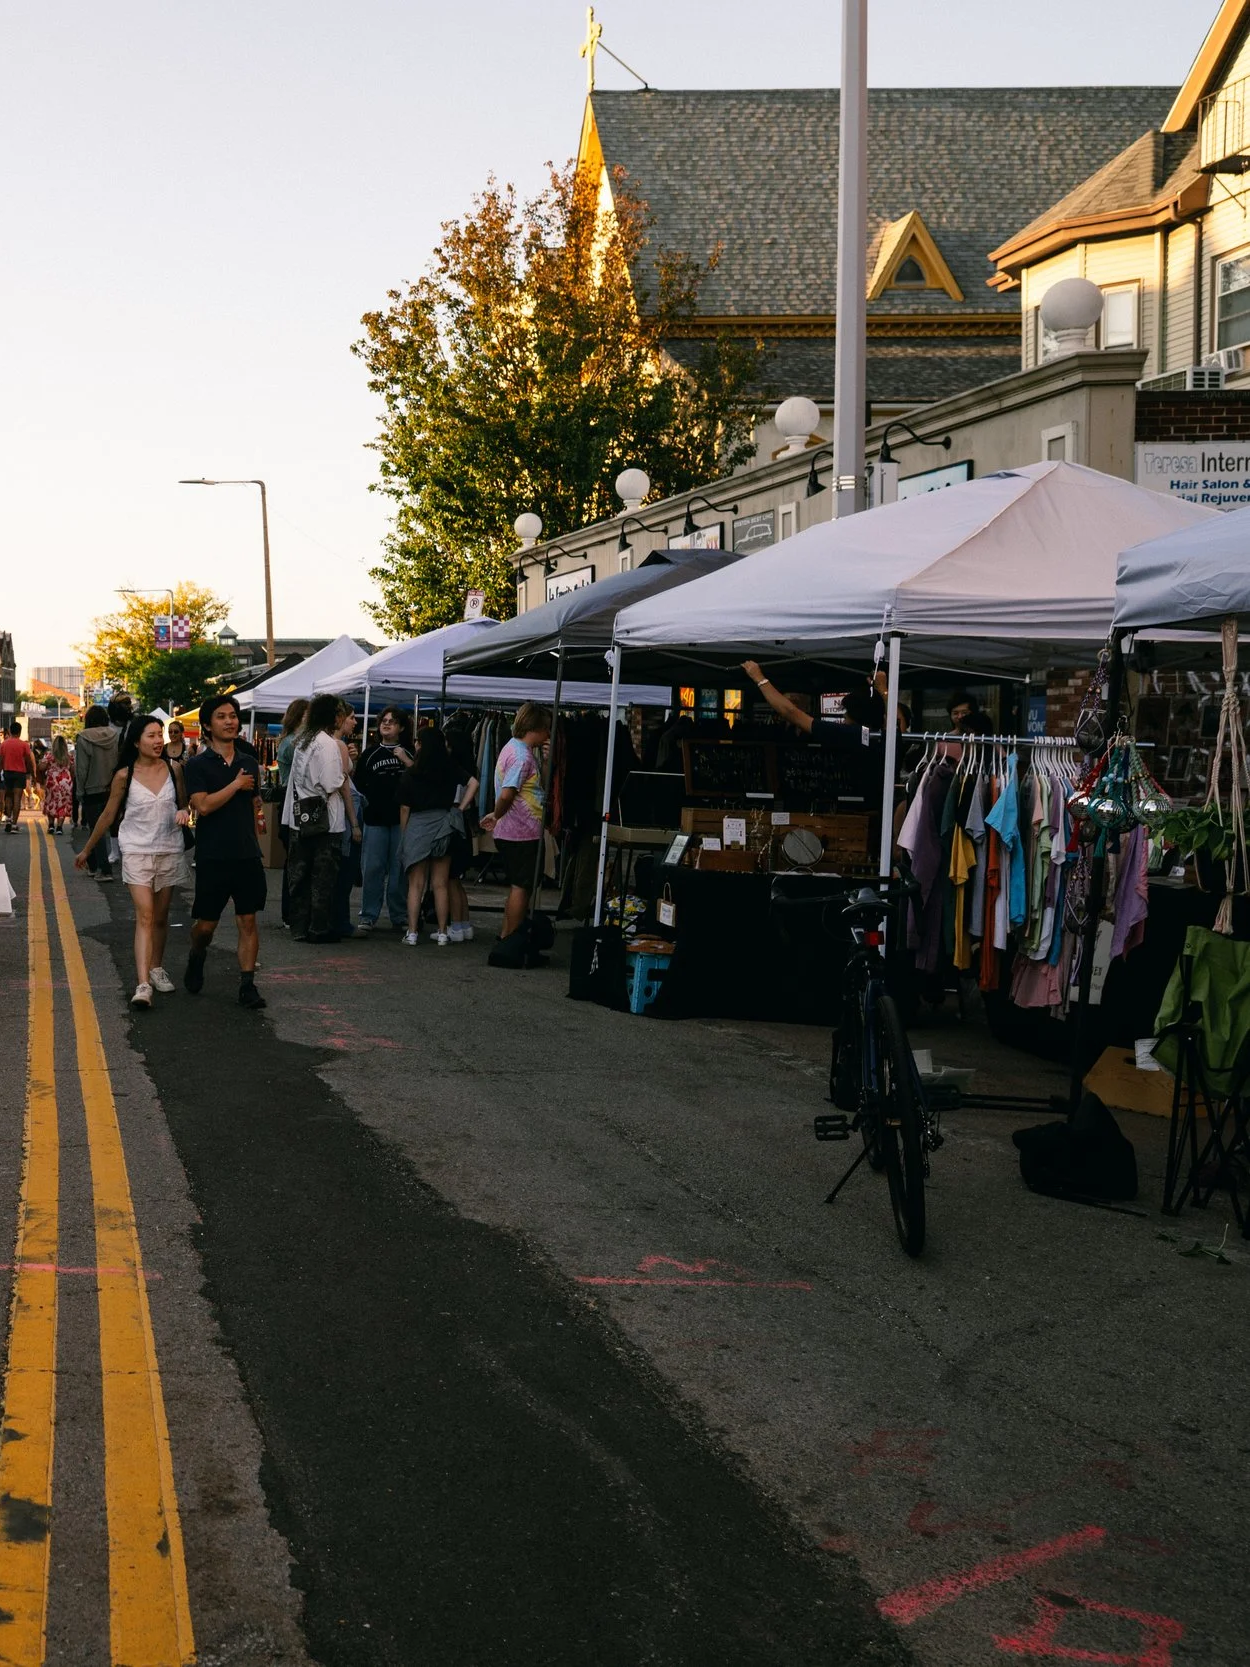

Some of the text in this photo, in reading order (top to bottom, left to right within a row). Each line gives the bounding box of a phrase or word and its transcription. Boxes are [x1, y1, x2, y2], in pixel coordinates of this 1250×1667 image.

[1144, 453, 1198, 474] Teresa
[1170, 479, 1199, 490] Hair
[1202, 479, 1239, 489] Salon
